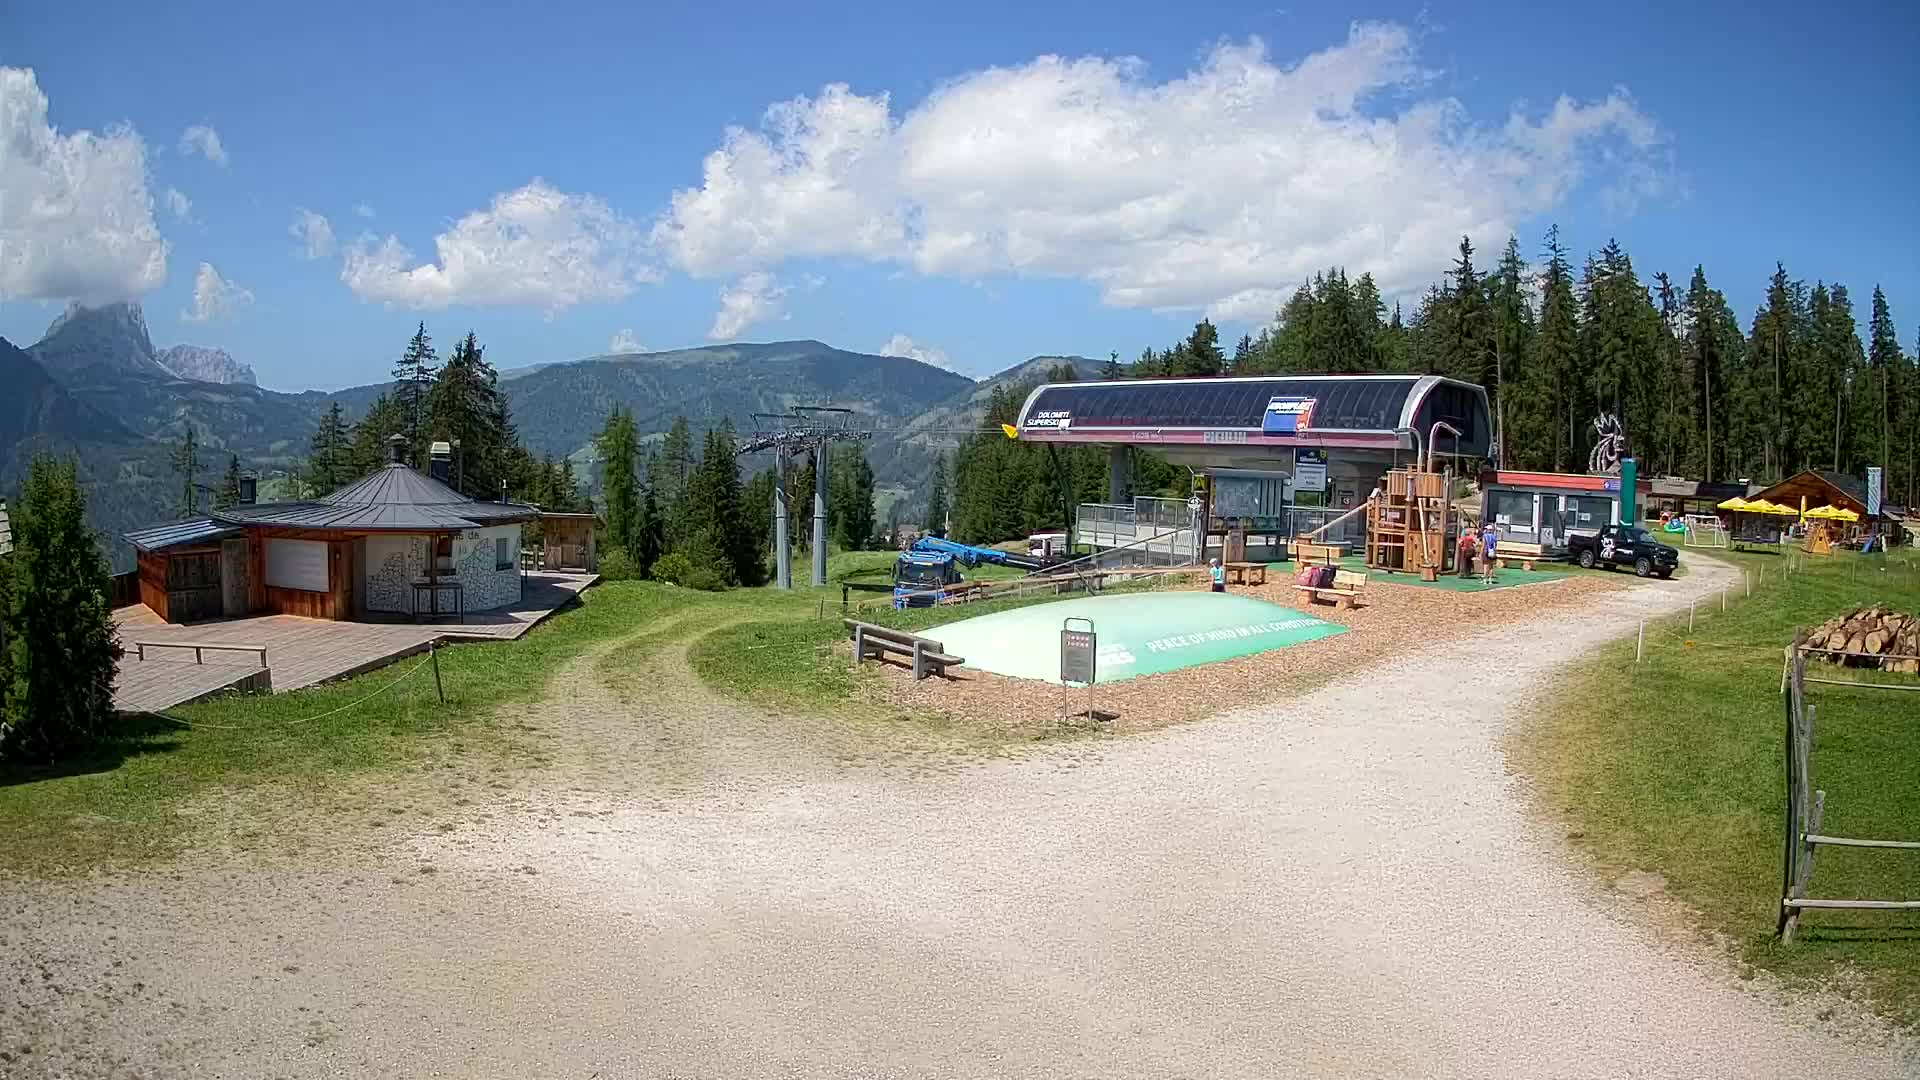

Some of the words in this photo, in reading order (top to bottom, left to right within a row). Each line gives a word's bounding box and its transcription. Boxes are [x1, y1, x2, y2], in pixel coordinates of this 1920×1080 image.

[1037, 411, 1070, 419] DOLOMITI
[1146, 636, 1191, 652] PEACE
[1190, 632, 1206, 644] OF
[1207, 629, 1236, 641] MIND
[1235, 626, 1250, 637] IN
[1250, 623, 1271, 635] ALL
